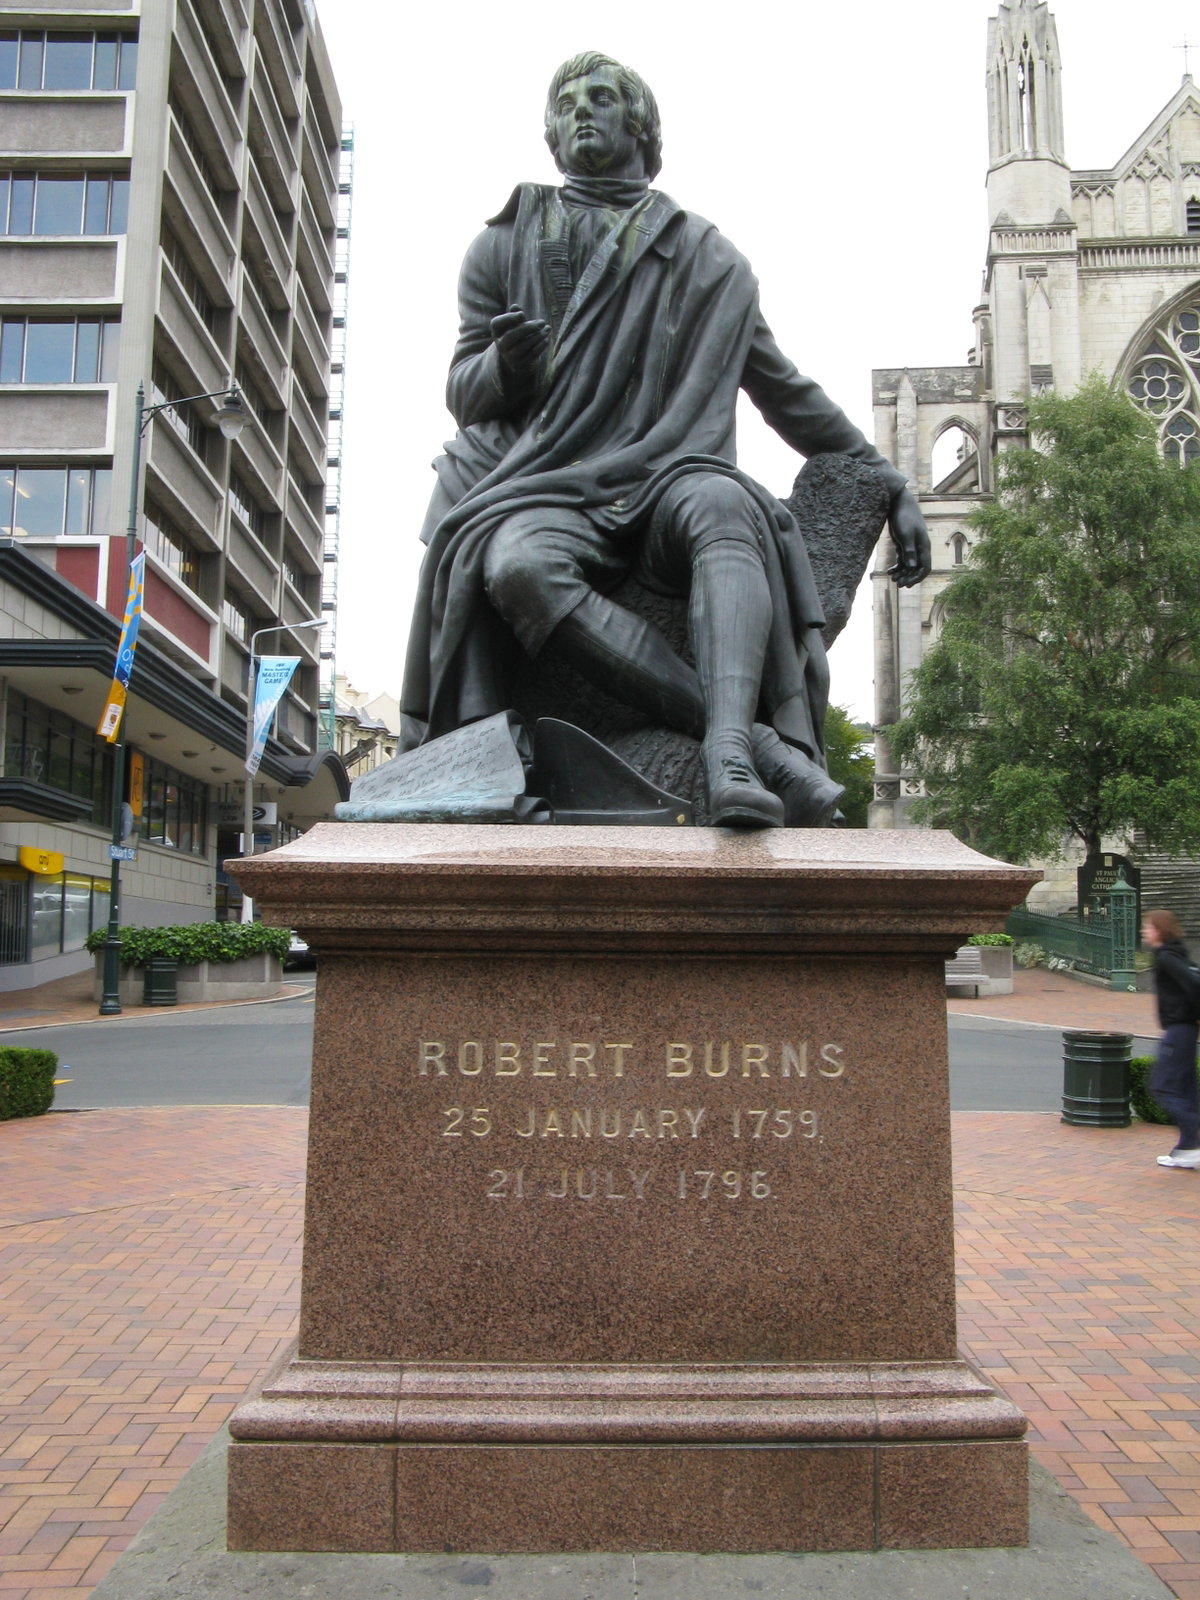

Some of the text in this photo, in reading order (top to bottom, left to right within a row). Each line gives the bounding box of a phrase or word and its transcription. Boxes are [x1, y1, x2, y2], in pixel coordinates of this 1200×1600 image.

[418, 1040, 845, 1078] ROBERT BURNS
[442, 1106, 493, 1137] 25
[515, 1107, 706, 1138] JANUARY
[486, 1168, 525, 1198] 21
[548, 1168, 650, 1199] JULY
